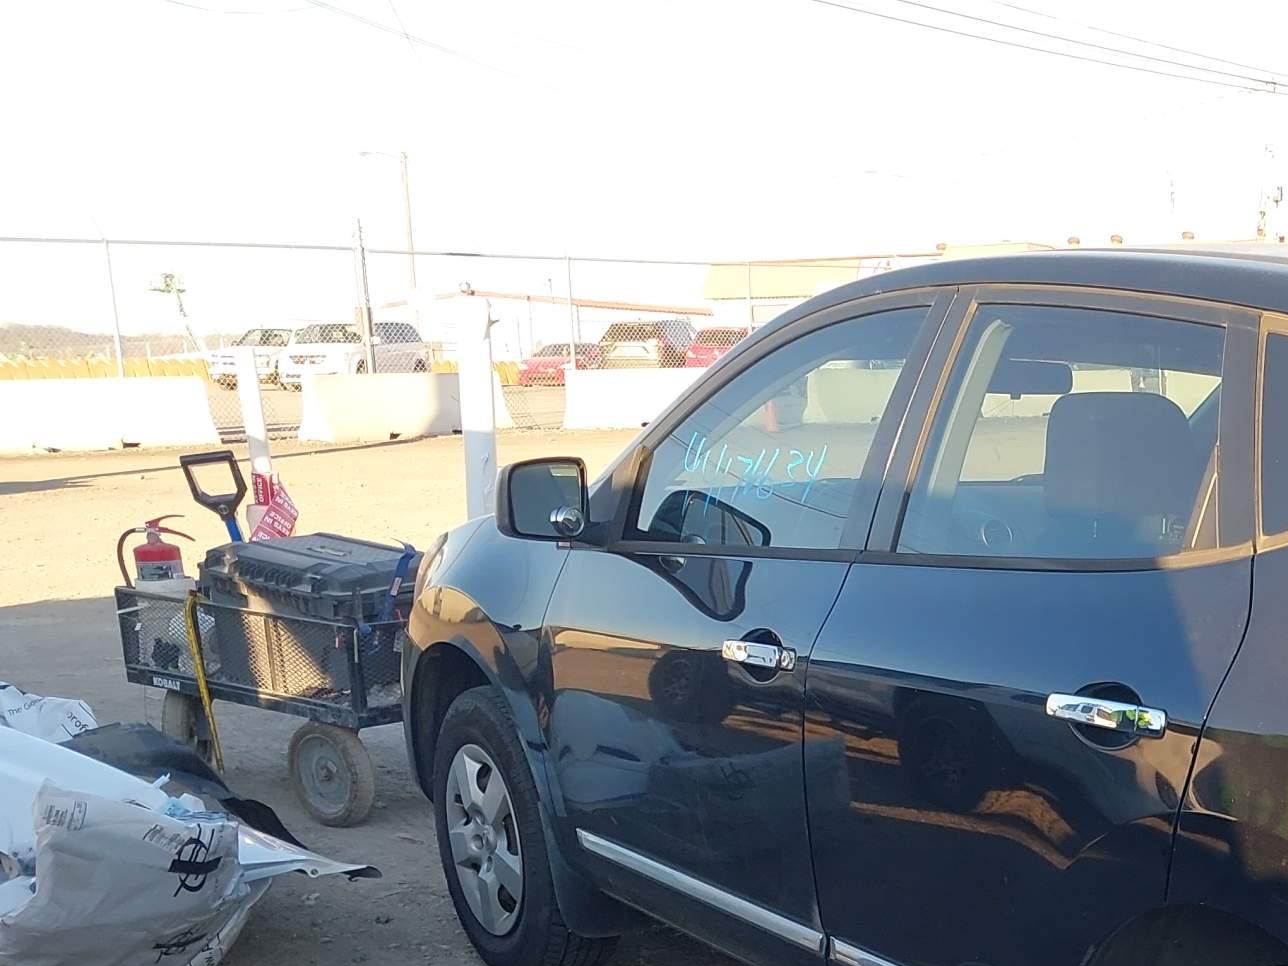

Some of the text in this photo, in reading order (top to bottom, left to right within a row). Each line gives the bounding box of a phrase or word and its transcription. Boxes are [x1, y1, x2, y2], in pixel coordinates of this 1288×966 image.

[263, 516, 274, 525] IN
[269, 511, 292, 529] OFFICE
[152, 675, 181, 691] KOBALT
